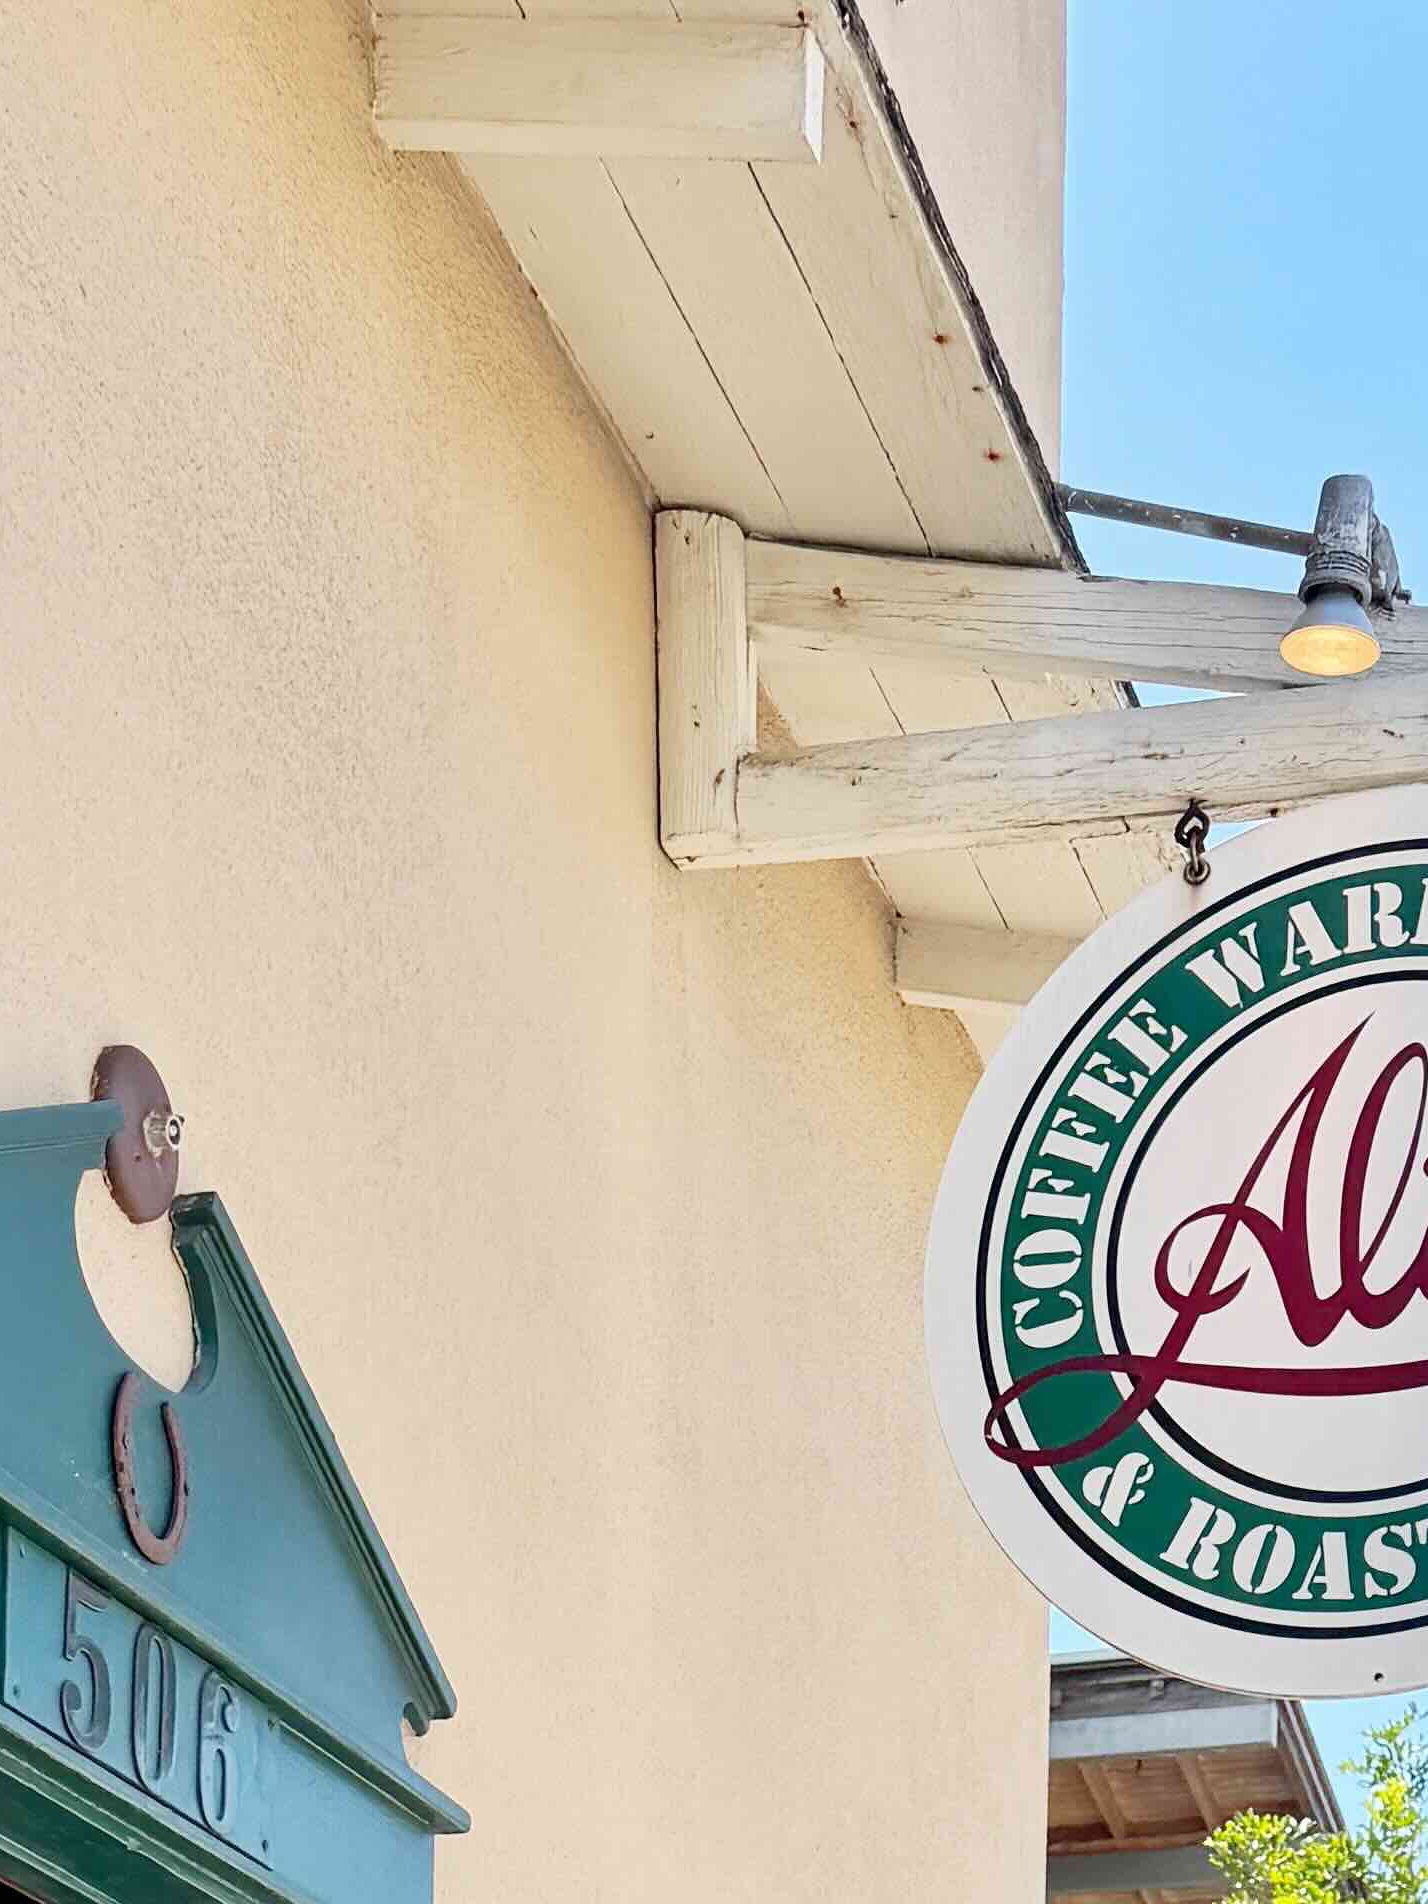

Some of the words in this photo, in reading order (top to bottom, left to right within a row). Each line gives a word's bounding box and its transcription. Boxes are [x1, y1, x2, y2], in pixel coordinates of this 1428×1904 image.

[1012, 997, 1189, 1353] COFFEE
[1081, 1450, 1156, 1529] &
[58, 1564, 243, 1838] 506
